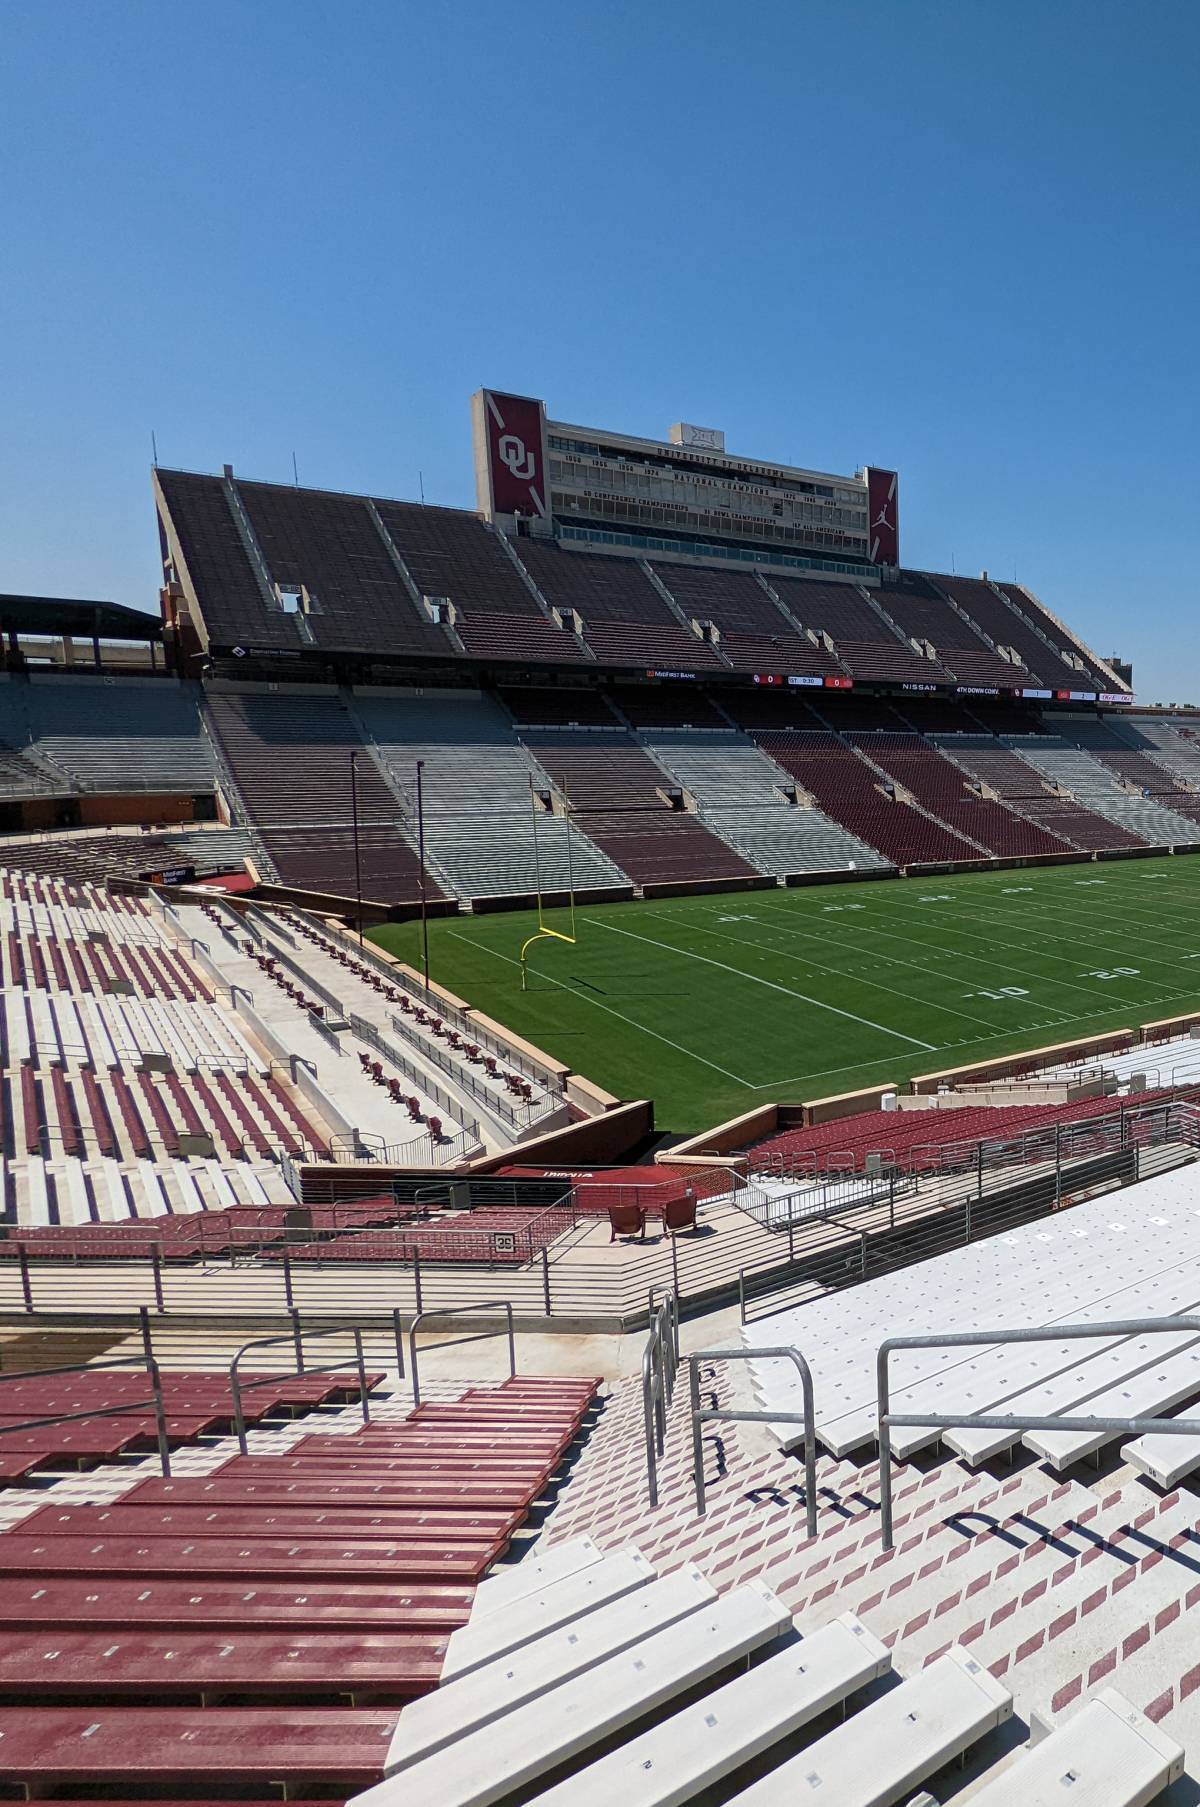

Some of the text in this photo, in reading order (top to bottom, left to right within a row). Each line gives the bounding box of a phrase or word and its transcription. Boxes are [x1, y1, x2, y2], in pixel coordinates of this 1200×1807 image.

[499, 435, 535, 480] OU
[657, 448, 717, 465] UNIVERSITY
[737, 463, 784, 478] OKLAHOMA
[674, 473, 717, 487] NATIONAL
[721, 482, 769, 496] CHAMPIONS
[594, 492, 637, 504] CONFERENCE
[638, 498, 689, 512] CHAMPIONSHIPS
[1089, 966, 1140, 980] 20
[977, 986, 1030, 1000] 10
